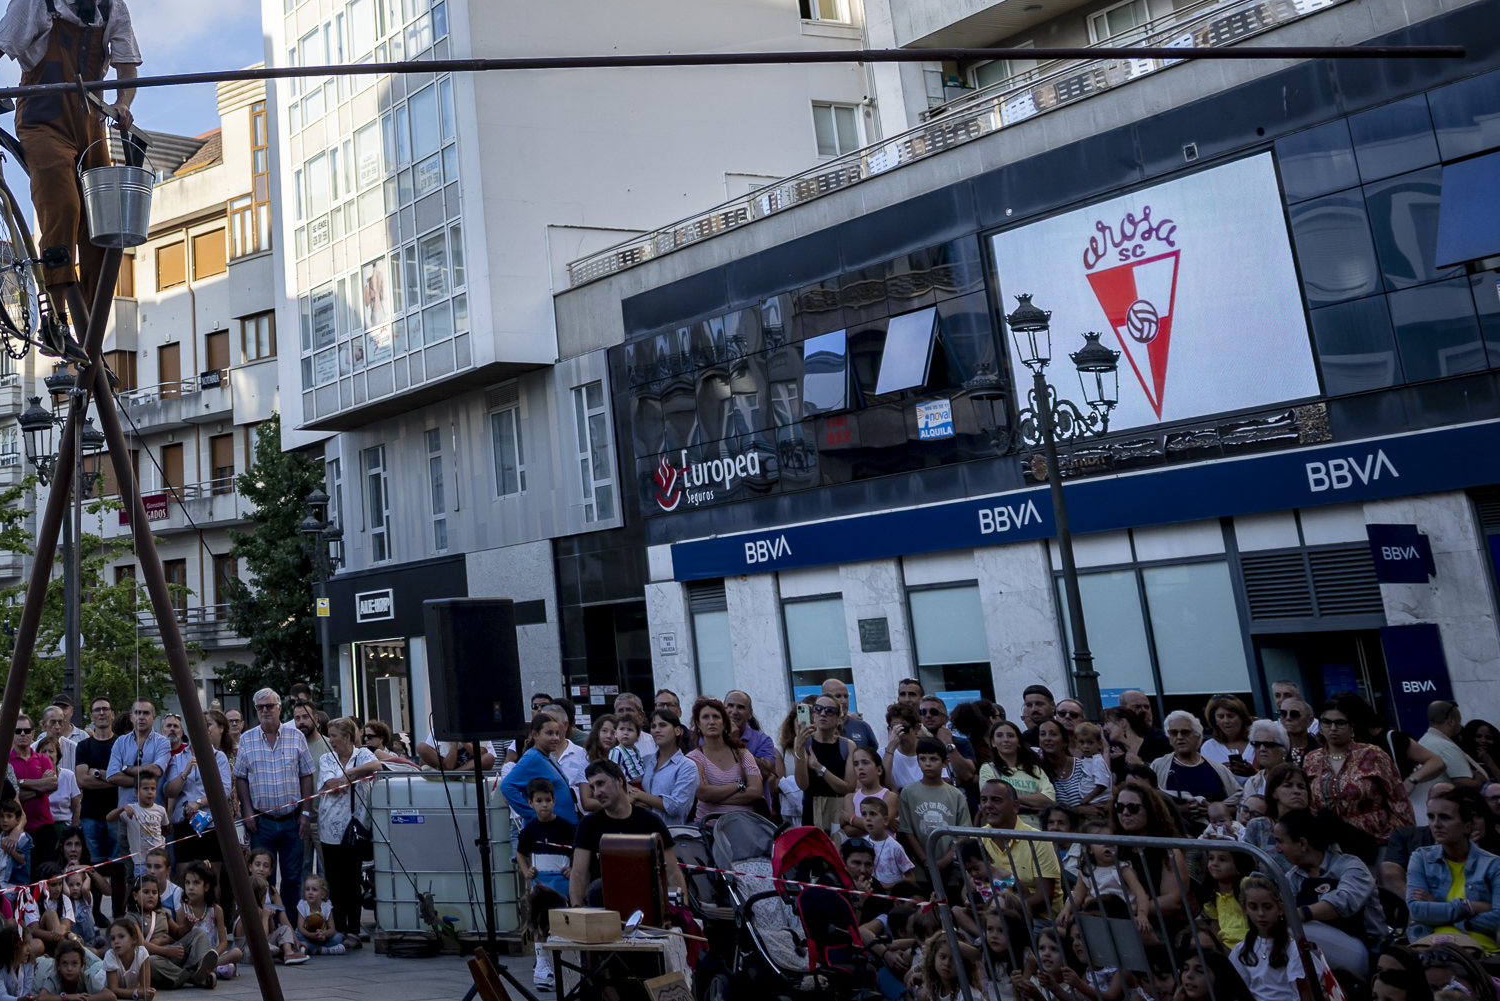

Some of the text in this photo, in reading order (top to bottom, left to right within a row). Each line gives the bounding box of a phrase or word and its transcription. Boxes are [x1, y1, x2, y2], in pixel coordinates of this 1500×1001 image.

[920, 426, 953, 438] ALQUILA
[681, 448, 760, 490] Europea
[1305, 449, 1400, 493] BBVA
[686, 488, 714, 506] Seguros
[978, 499, 1042, 534] BBVA
[744, 534, 792, 565] BBVA
[1381, 546, 1420, 560] BBVA
[1402, 680, 1437, 693] BBVA
[914, 801, 929, 817] KEEP
